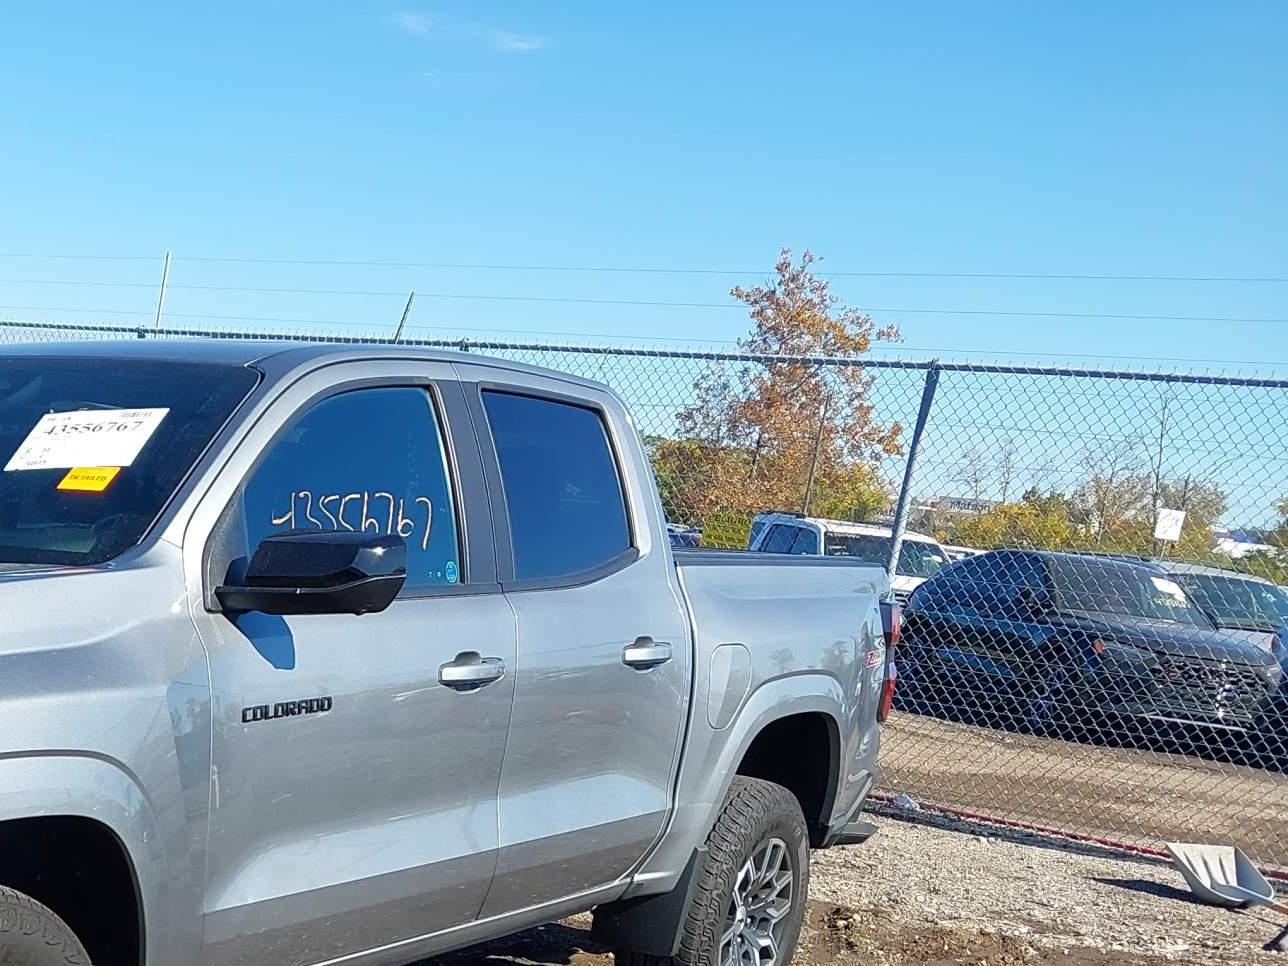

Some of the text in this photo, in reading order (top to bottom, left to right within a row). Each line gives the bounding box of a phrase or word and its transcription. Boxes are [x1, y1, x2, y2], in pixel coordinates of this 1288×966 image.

[43, 420, 144, 436] 43556767
[69, 473, 108, 482] DETAILED
[241, 696, 332, 723] COLORADO
